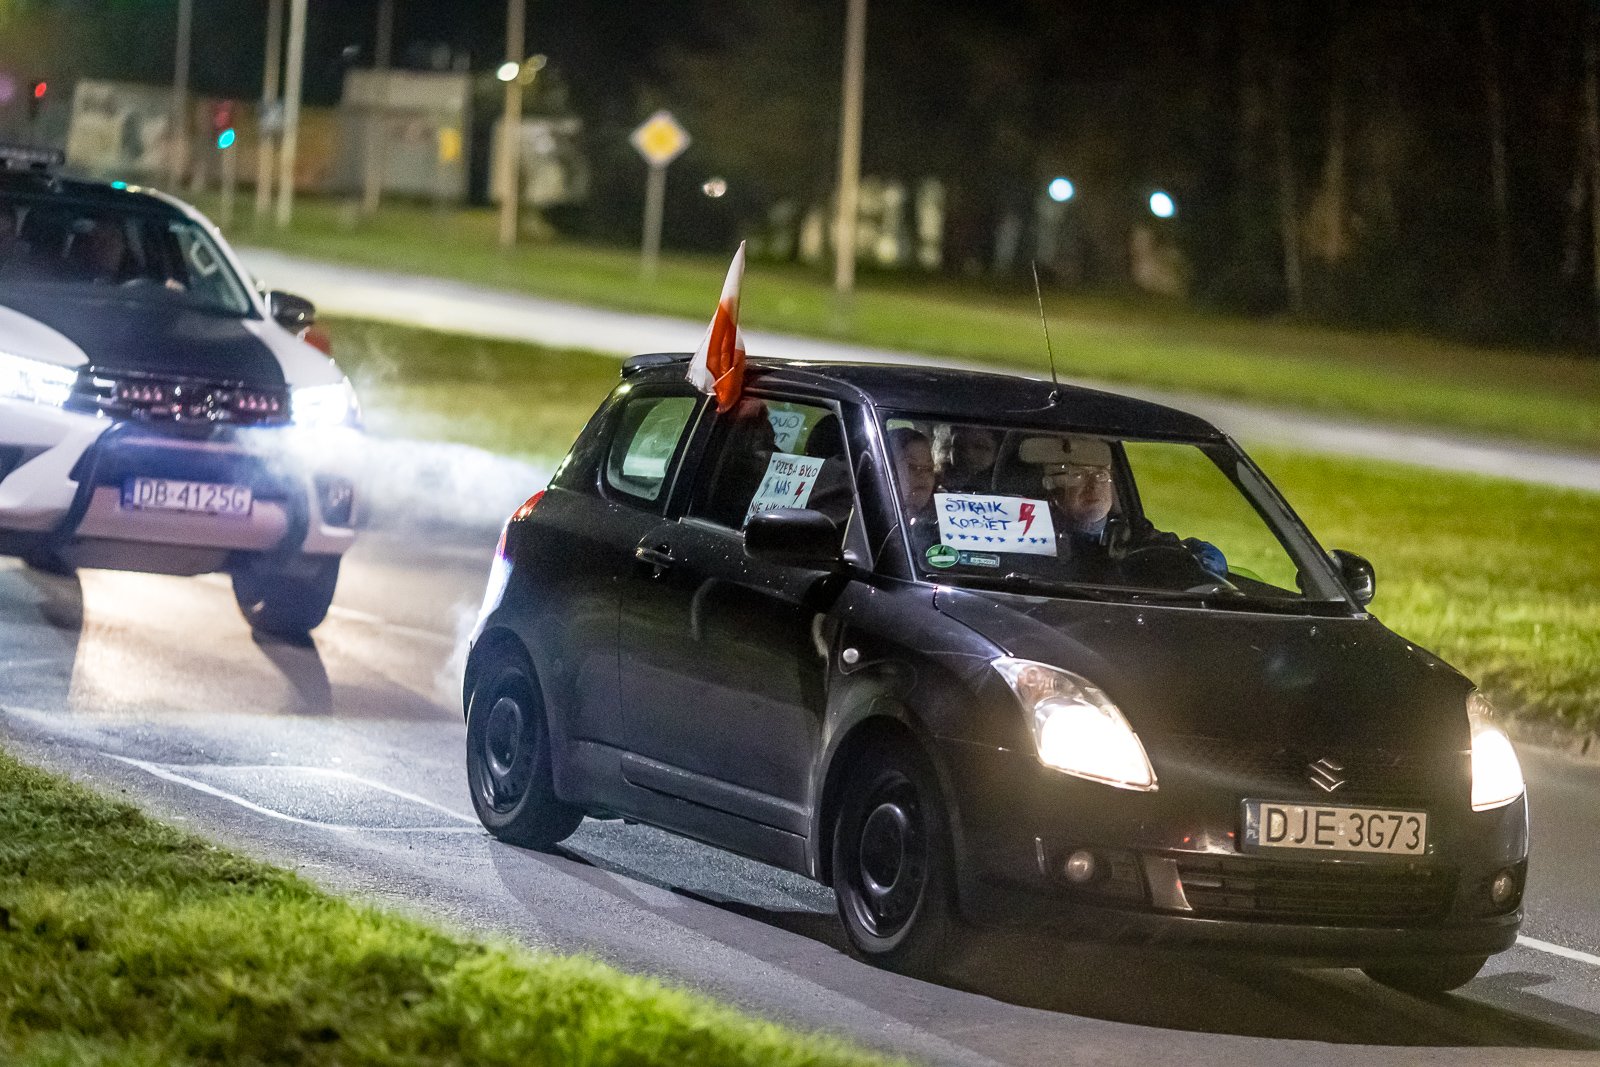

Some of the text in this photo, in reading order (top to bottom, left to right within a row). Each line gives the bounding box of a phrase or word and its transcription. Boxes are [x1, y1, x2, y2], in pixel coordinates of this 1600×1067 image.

[140, 480, 167, 505] DB
[177, 483, 244, 512] 4125G
[1246, 830, 1259, 839] PL
[1266, 807, 1421, 850] DJE 3G73
